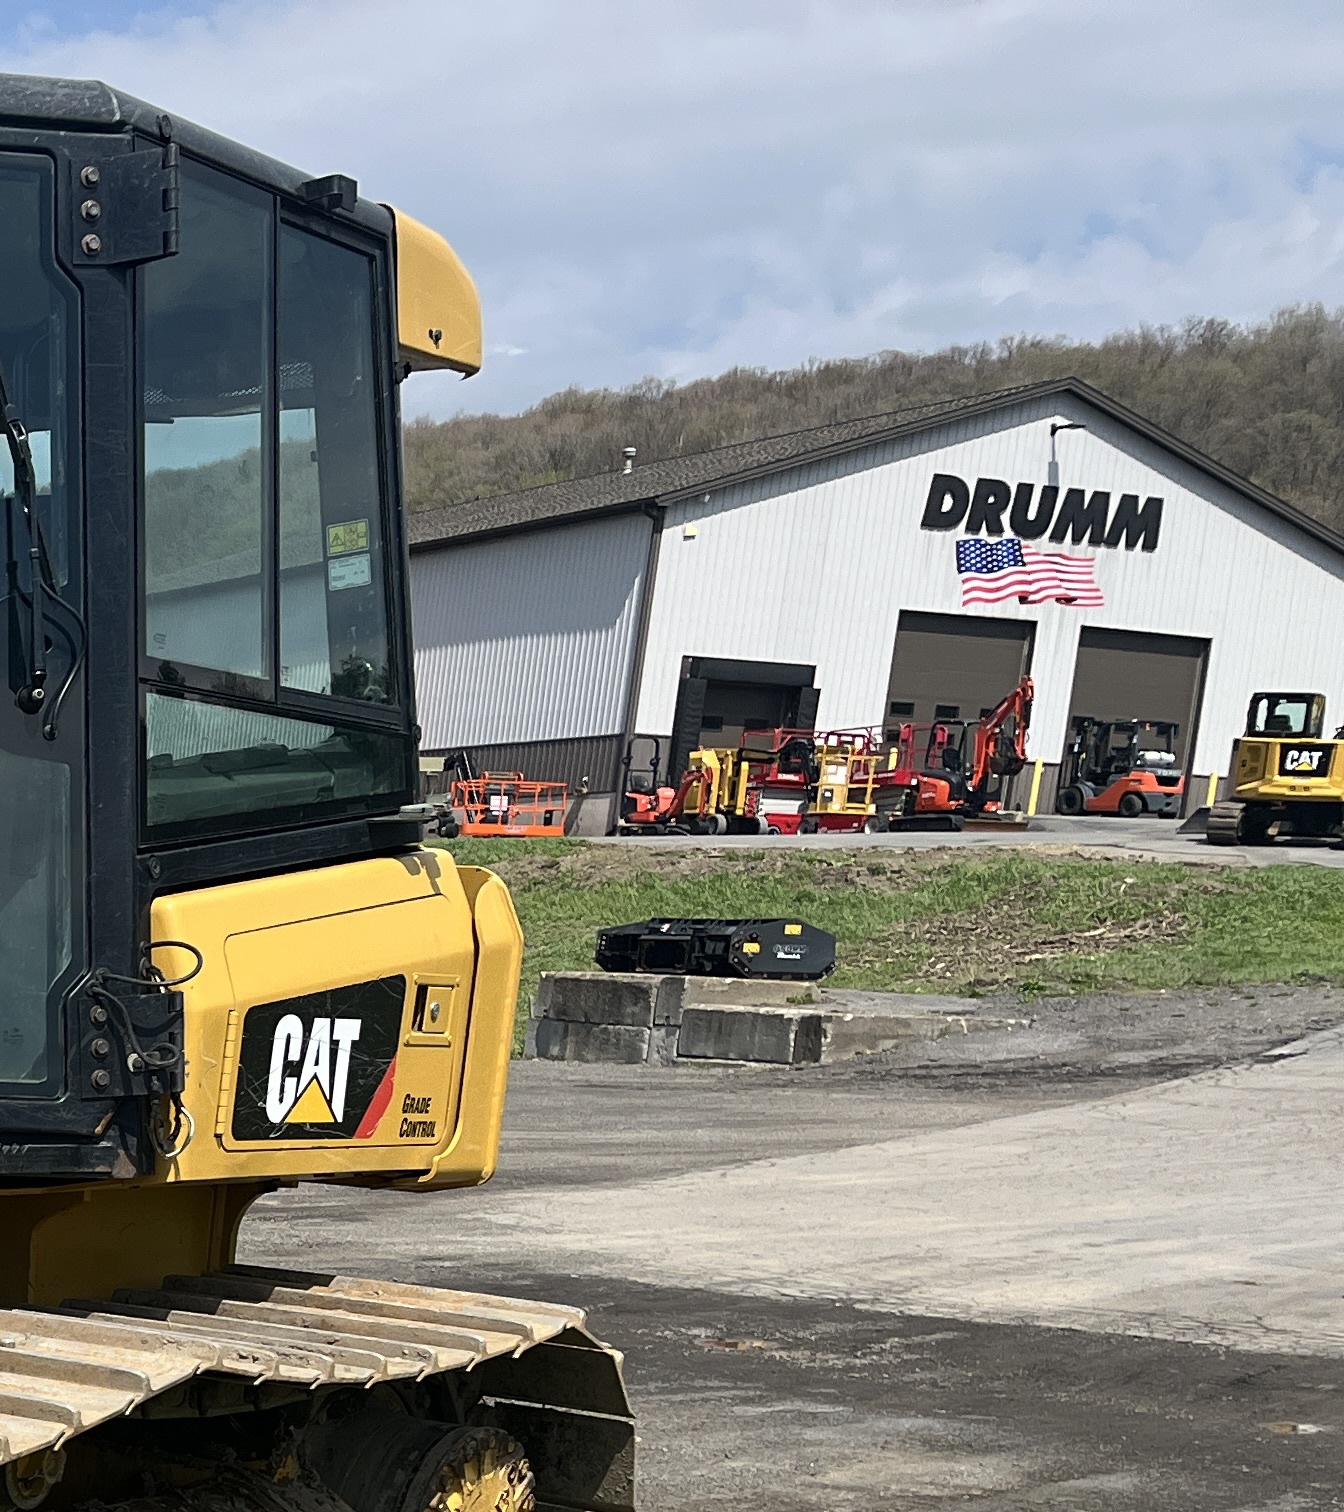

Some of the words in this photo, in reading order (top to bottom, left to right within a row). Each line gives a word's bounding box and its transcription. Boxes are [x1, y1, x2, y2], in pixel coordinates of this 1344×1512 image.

[920, 473, 1164, 553] DRUMM
[1284, 750, 1323, 771] CAT
[265, 1014, 362, 1124] CAT
[402, 1093, 432, 1114] GRADE
[399, 1117, 437, 1138] CONTROL
